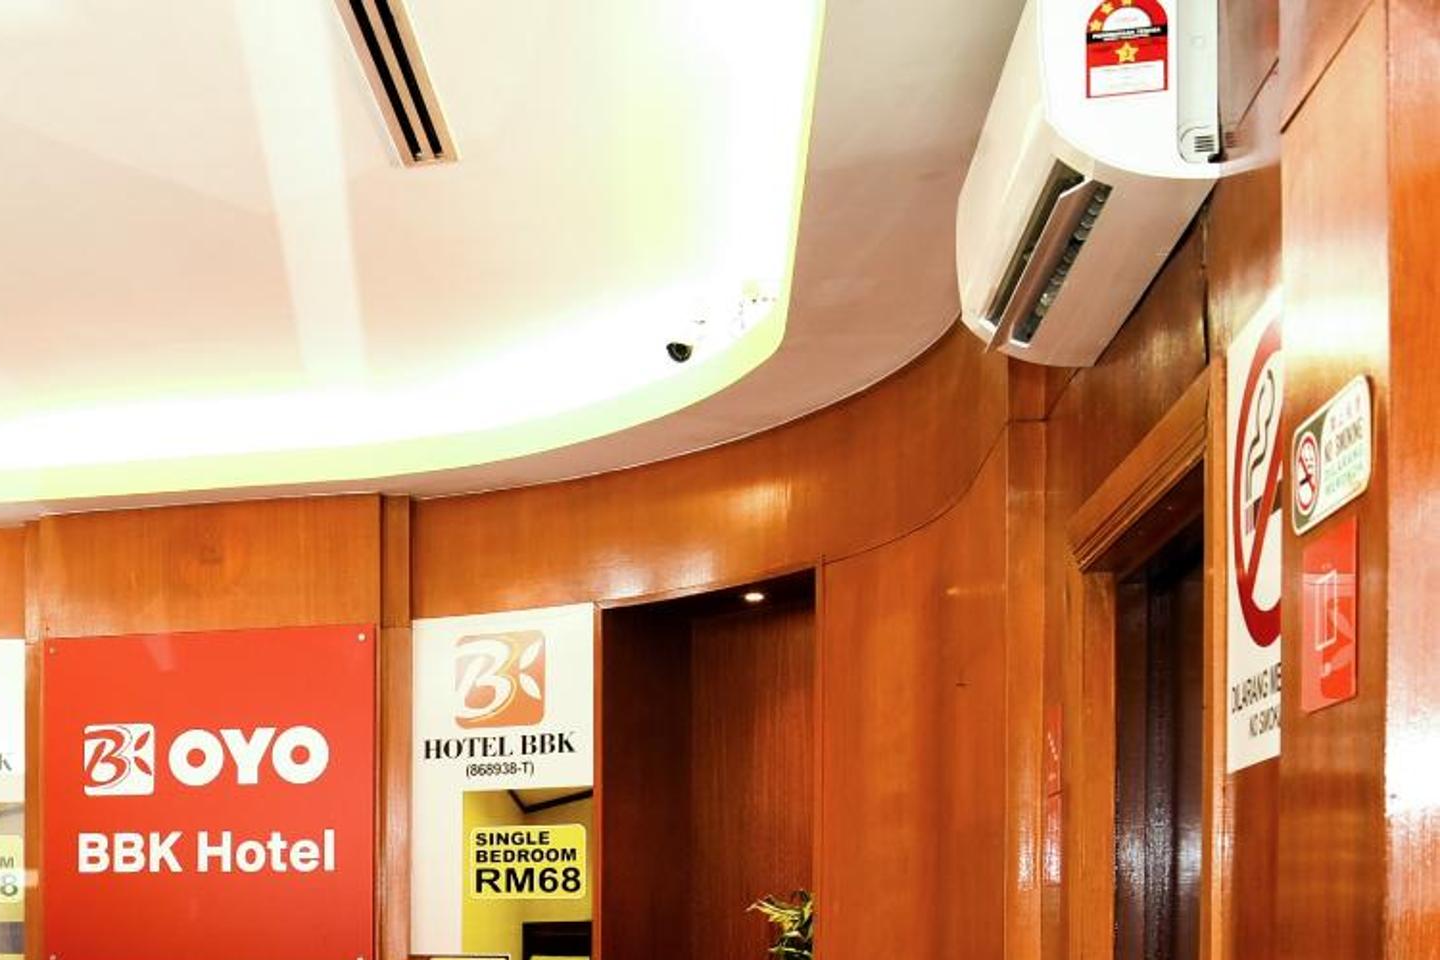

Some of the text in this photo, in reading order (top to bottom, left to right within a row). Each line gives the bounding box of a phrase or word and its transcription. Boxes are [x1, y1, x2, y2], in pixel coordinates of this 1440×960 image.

[168, 725, 330, 787] OYO
[424, 731, 577, 760] HOTEL BBK
[466, 761, 535, 780] (868938-T)
[78, 829, 335, 873] BBK Hotel
[476, 831, 551, 846] SINGLE
[476, 848, 577, 863] BEDROOM
[476, 867, 581, 894] RM68
